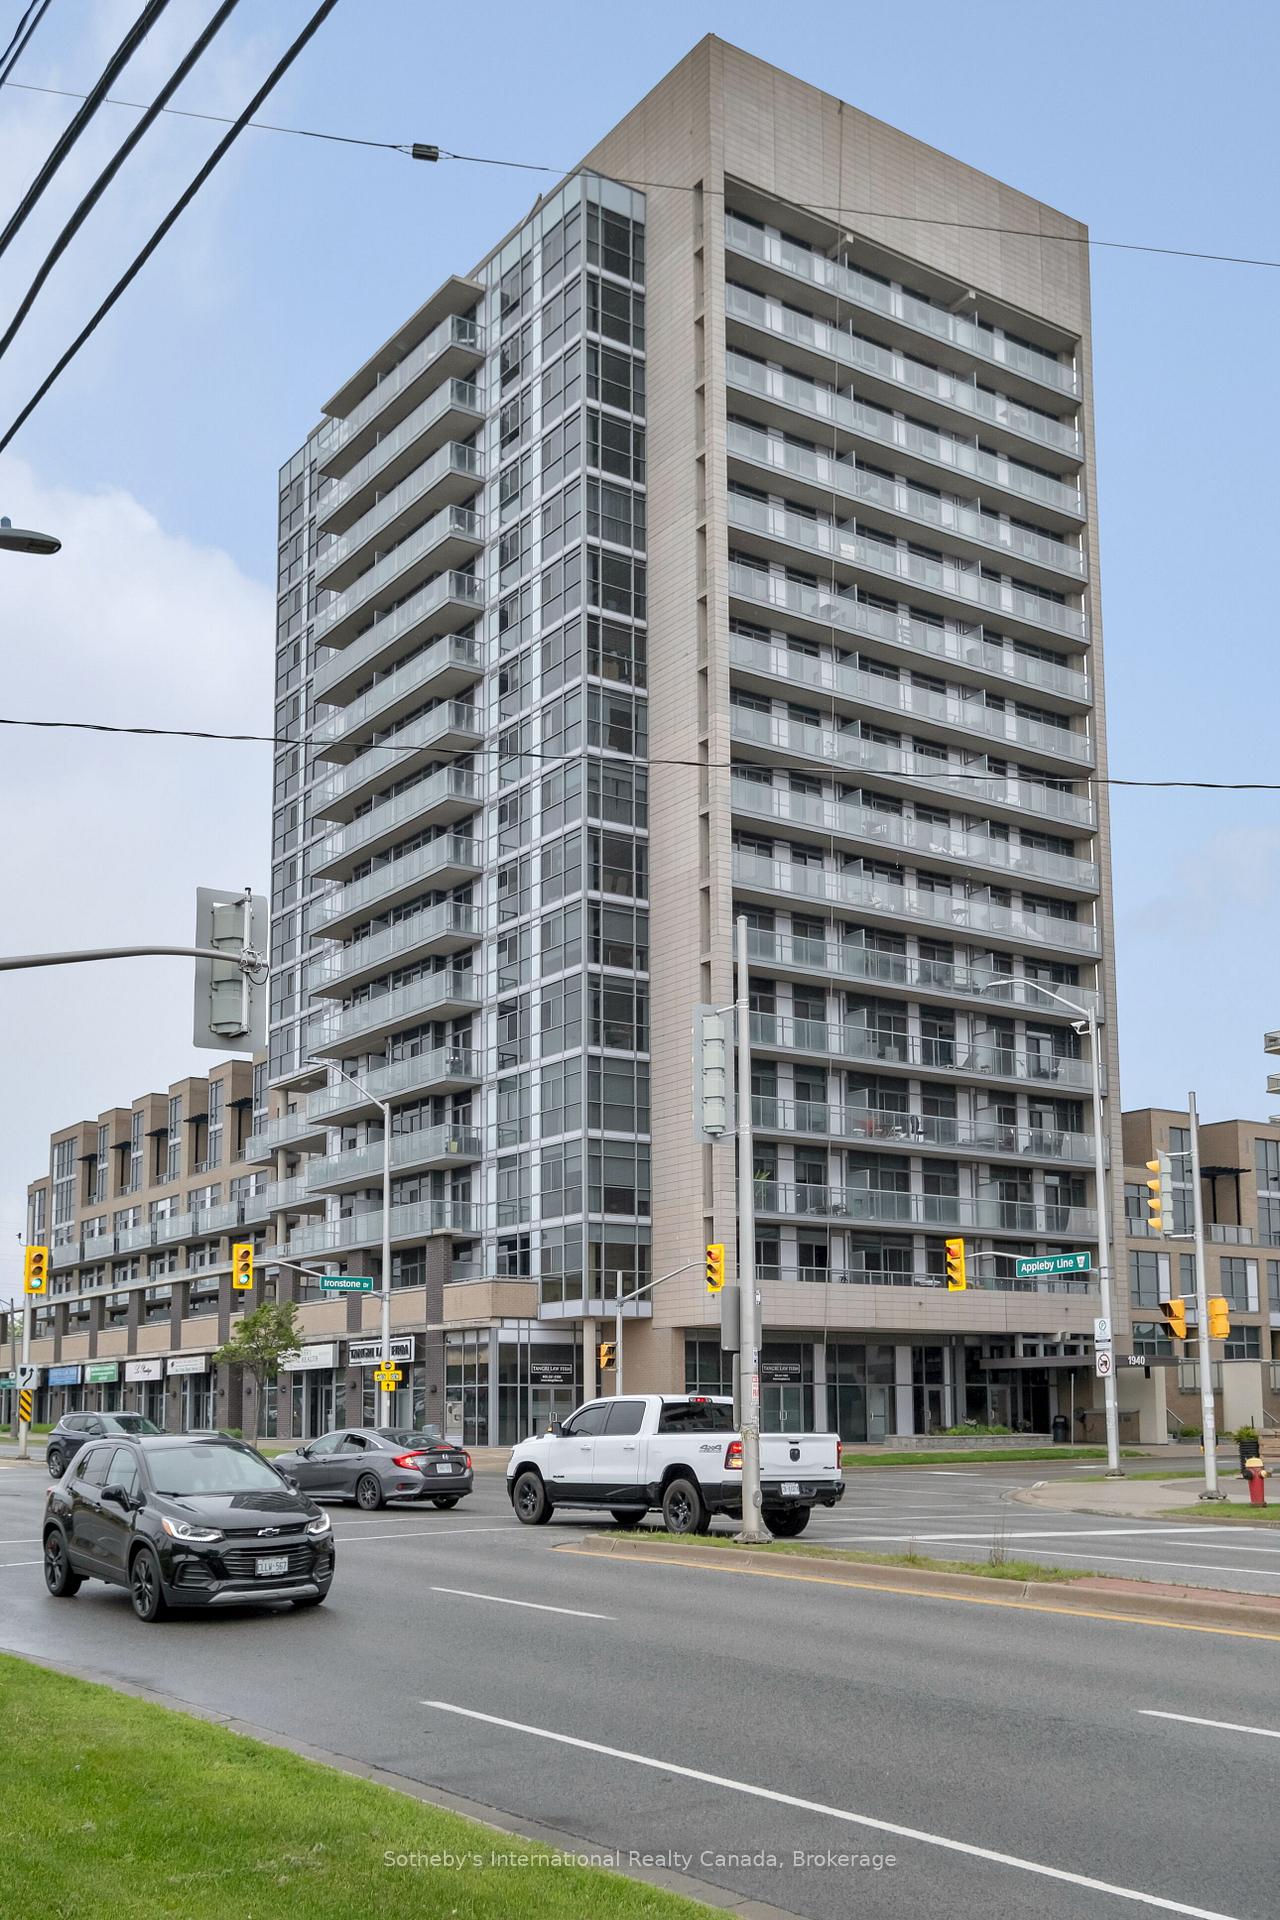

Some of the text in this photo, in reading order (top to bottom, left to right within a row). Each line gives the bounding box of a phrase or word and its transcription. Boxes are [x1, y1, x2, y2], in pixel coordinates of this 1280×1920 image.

[1021, 1260, 1054, 1274] Appleby
[1056, 1258, 1074, 1269] Line
[324, 1279, 361, 1288] Ironstone
[391, 1344, 409, 1356] FIRM
[1128, 1355, 1146, 1366] 1940
